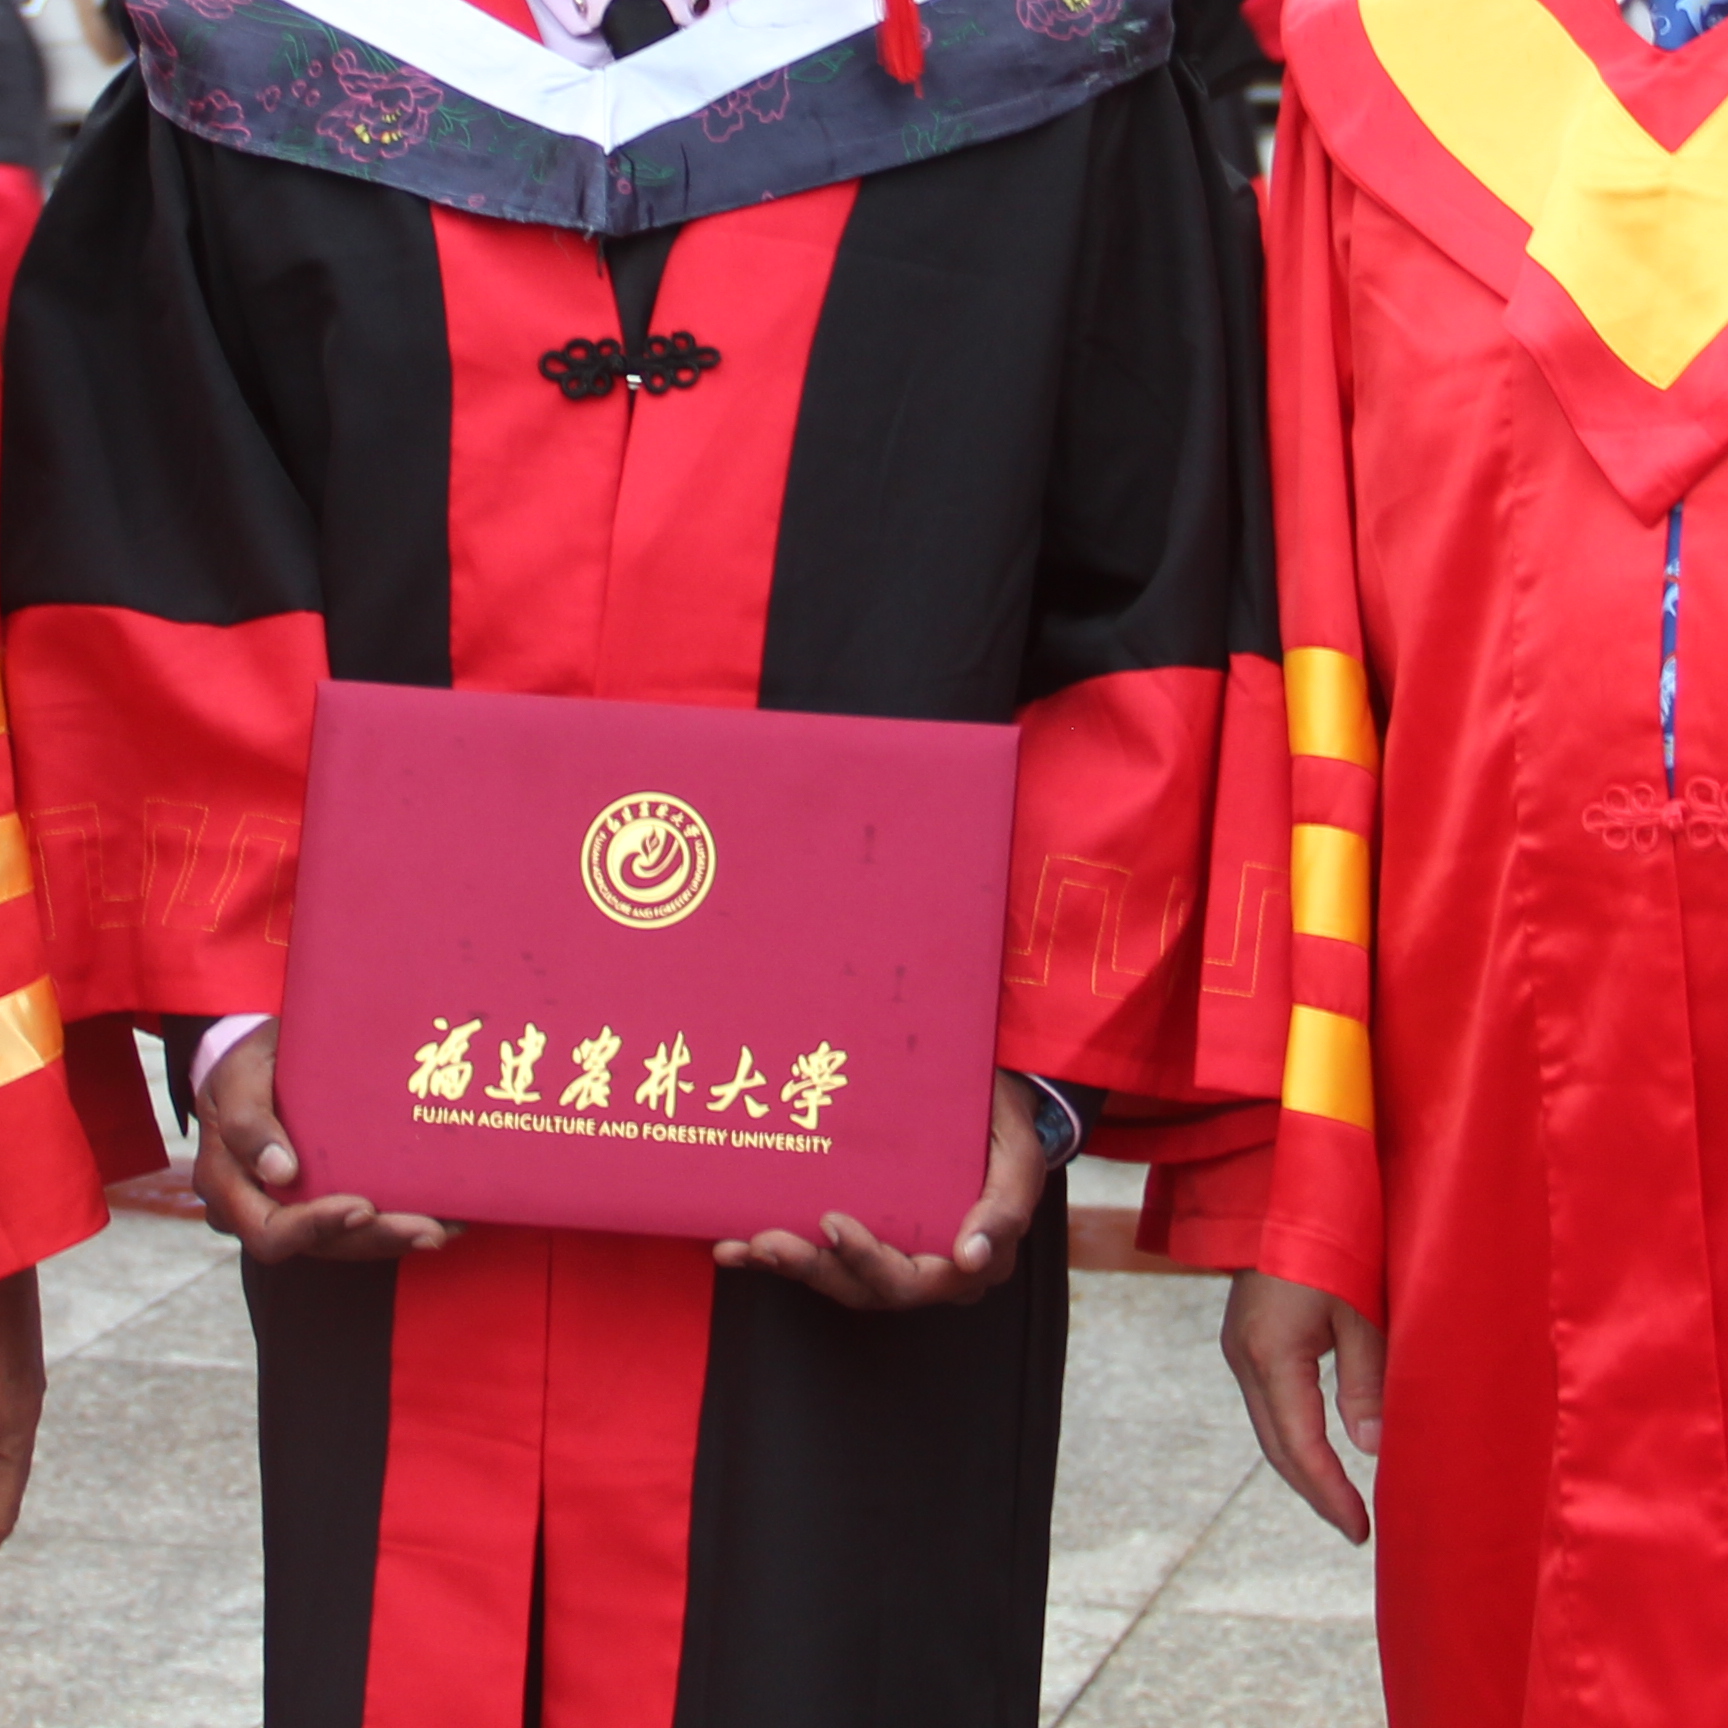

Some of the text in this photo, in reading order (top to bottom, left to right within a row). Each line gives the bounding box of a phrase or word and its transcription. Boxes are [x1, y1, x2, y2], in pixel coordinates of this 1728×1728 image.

[412, 1104, 834, 1155] FUJIAN AGRICULTURE AND FORESTRY UNIVERSITY
